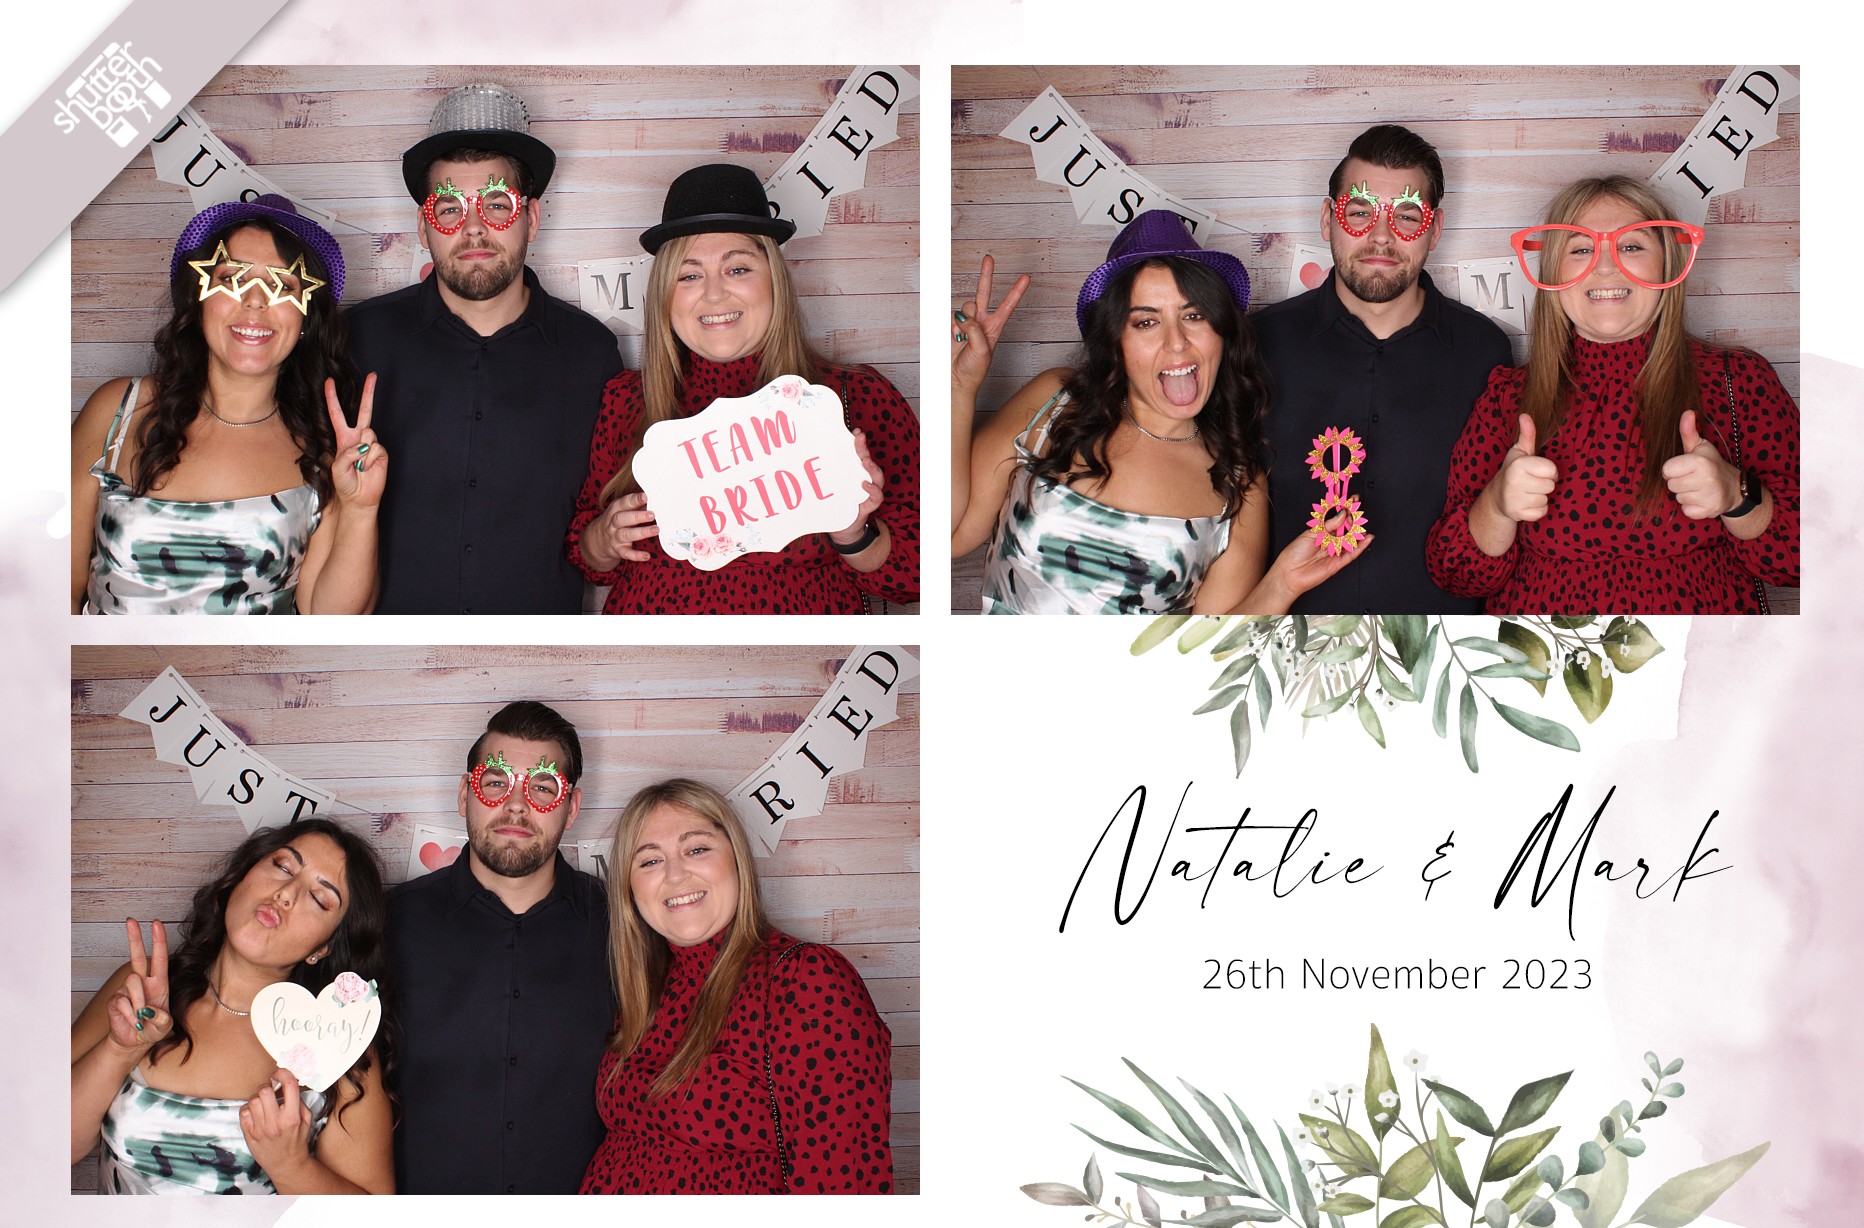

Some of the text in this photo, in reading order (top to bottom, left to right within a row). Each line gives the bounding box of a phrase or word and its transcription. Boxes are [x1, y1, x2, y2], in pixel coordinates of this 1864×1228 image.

[677, 410, 797, 480] TEAM
[699, 456, 834, 536] BRIDE
[149, 694, 319, 823] JUST
[272, 996, 371, 1054] hooray!
